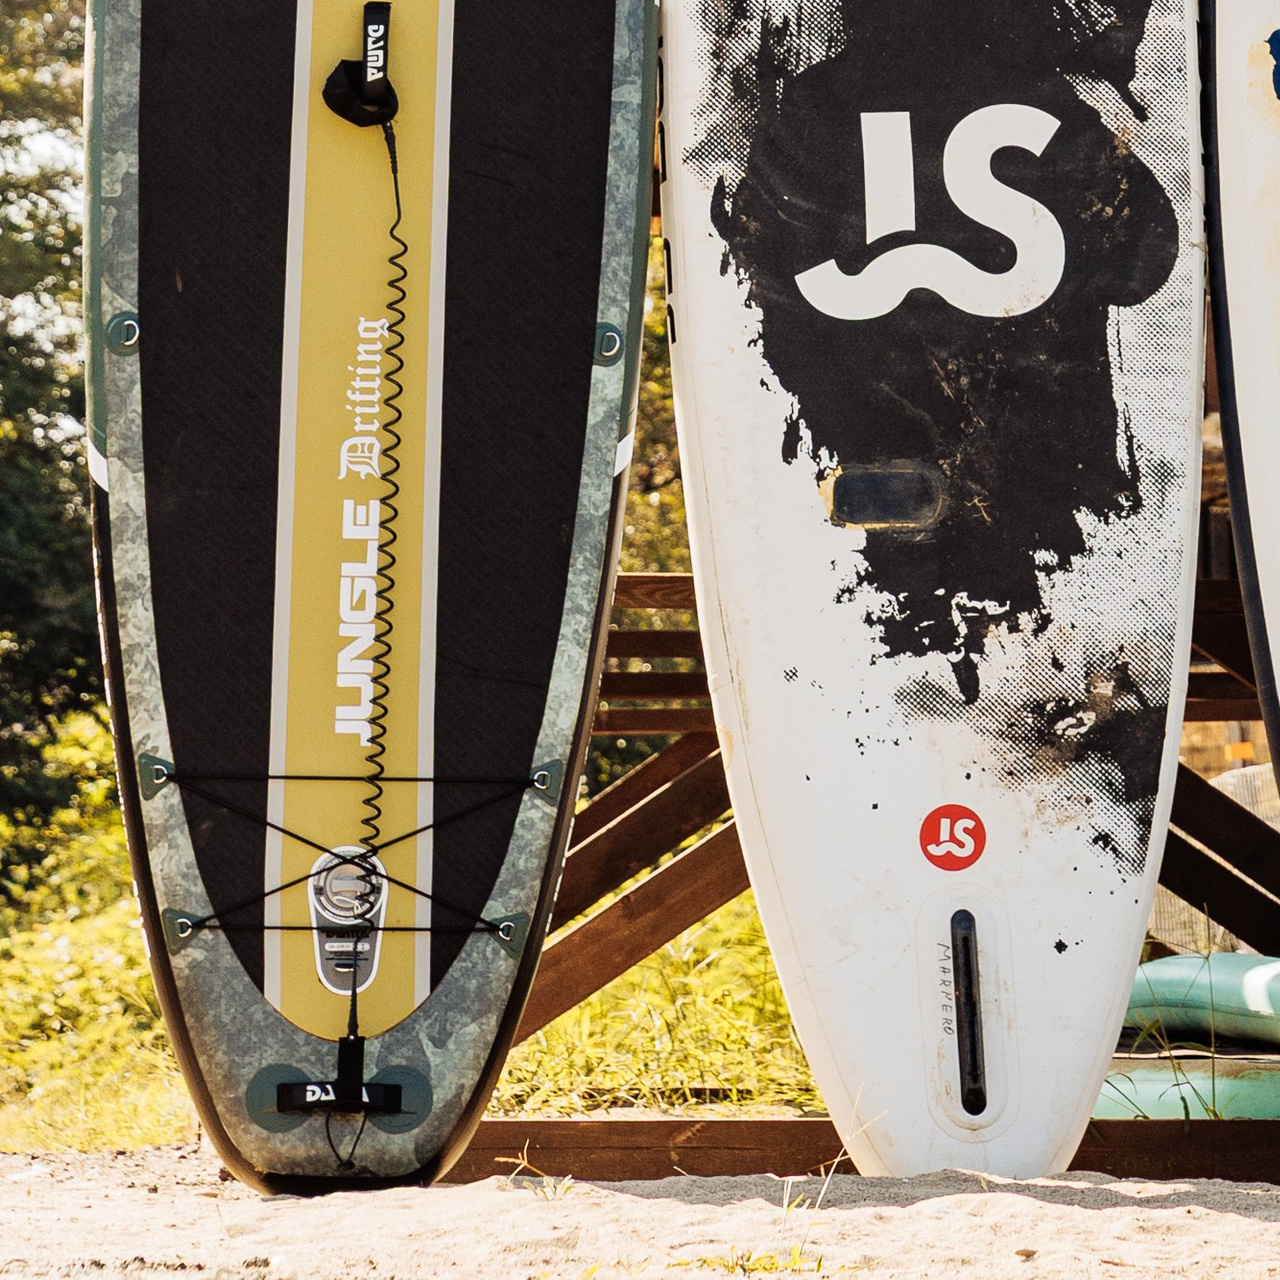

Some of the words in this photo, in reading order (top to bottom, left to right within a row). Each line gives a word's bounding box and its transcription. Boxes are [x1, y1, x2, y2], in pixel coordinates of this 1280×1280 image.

[367, 24, 385, 82] DAMA
[794, 103, 1066, 321] JS
[337, 316, 390, 480] Drifting
[334, 498, 381, 747] JUNGLE
[926, 817, 977, 858] JS
[305, 1084, 370, 1103] DA
